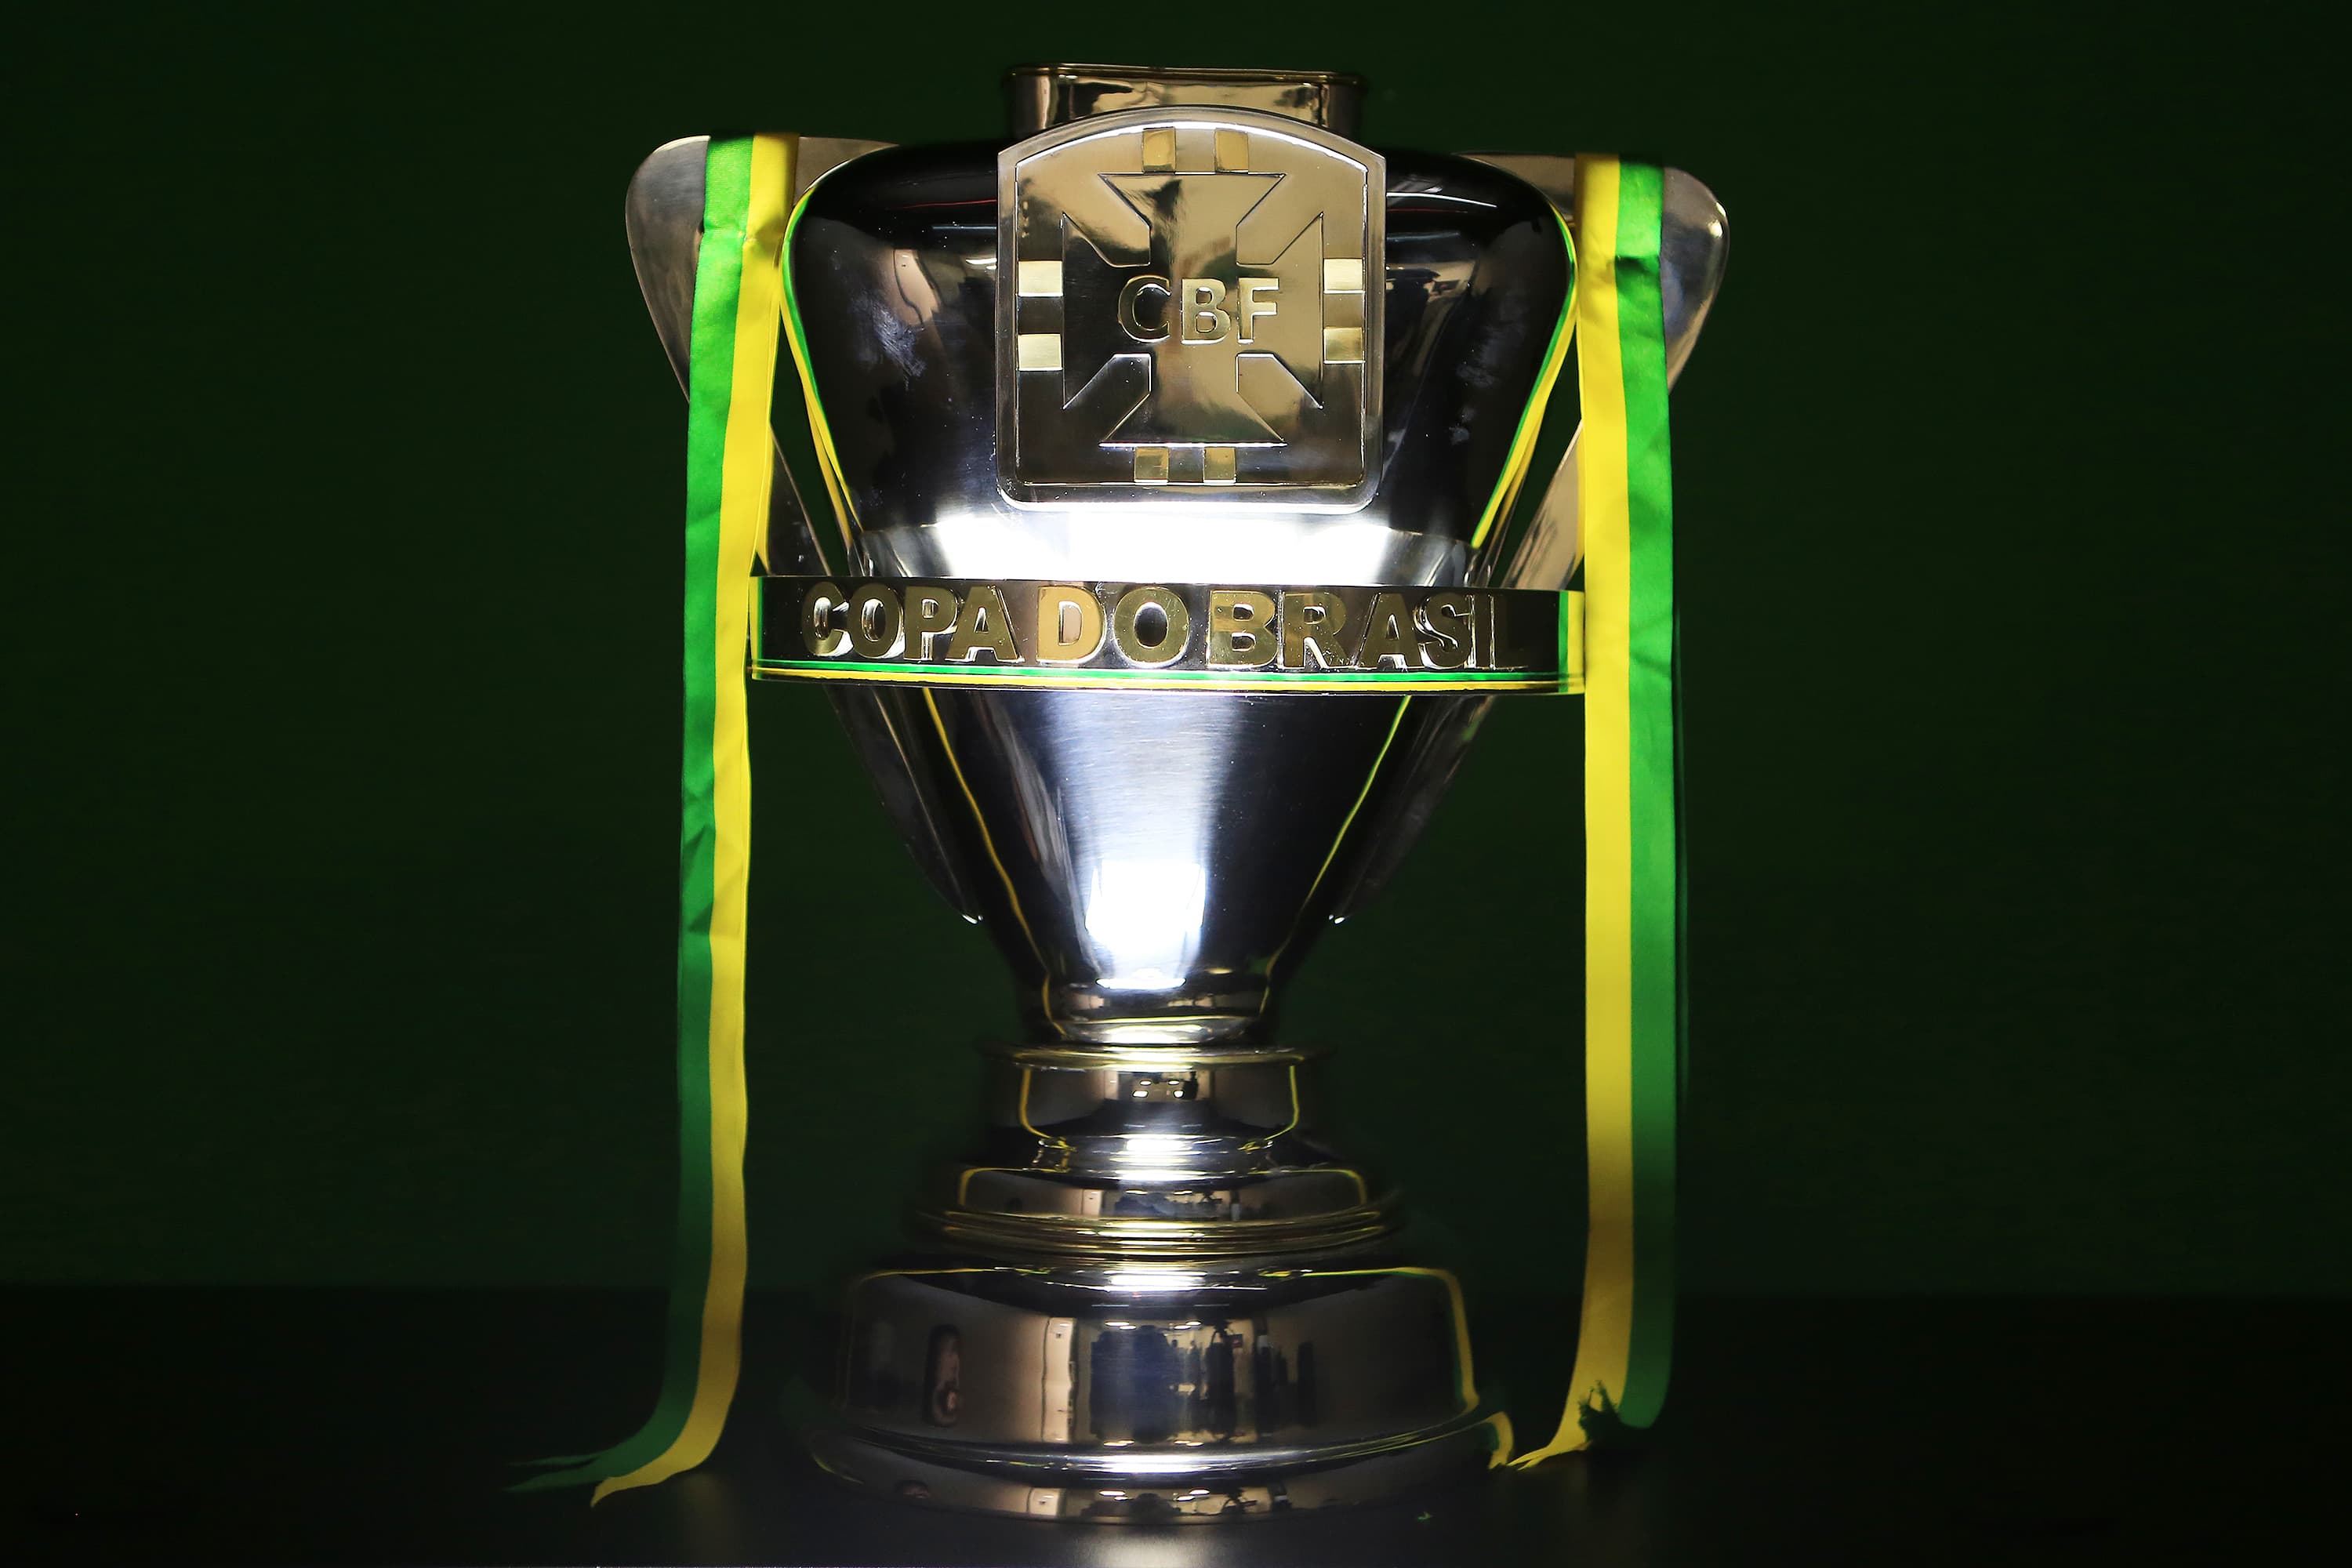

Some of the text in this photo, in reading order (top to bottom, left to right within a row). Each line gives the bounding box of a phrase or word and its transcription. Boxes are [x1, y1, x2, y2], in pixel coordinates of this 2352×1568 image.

[1117, 274, 1280, 345] CBF
[801, 581, 1528, 671] COPA DO BRASIL
